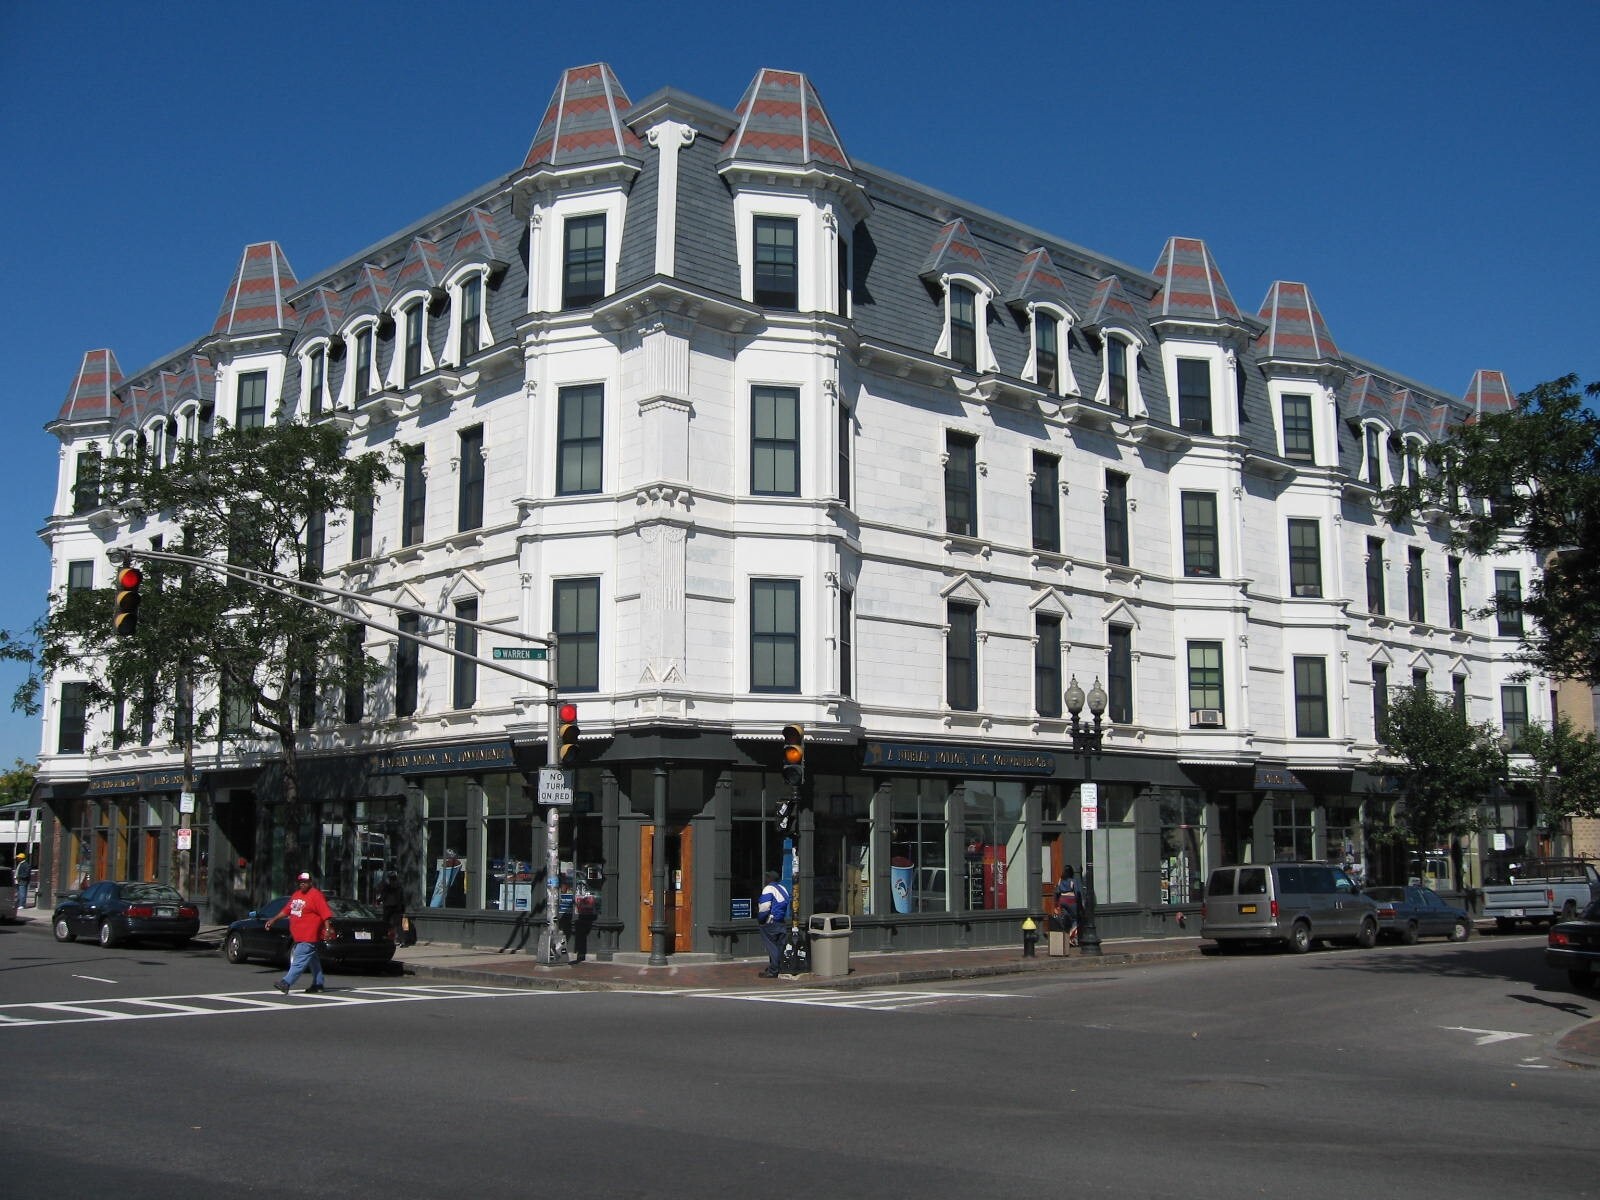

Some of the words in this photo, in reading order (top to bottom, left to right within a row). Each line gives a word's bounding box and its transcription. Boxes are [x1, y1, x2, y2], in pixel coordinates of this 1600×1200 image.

[502, 650, 530, 659] WARREN
[550, 773, 562, 781] NO
[546, 782, 565, 790] TURN
[541, 792, 552, 800] ON
[555, 792, 570, 800] RED
